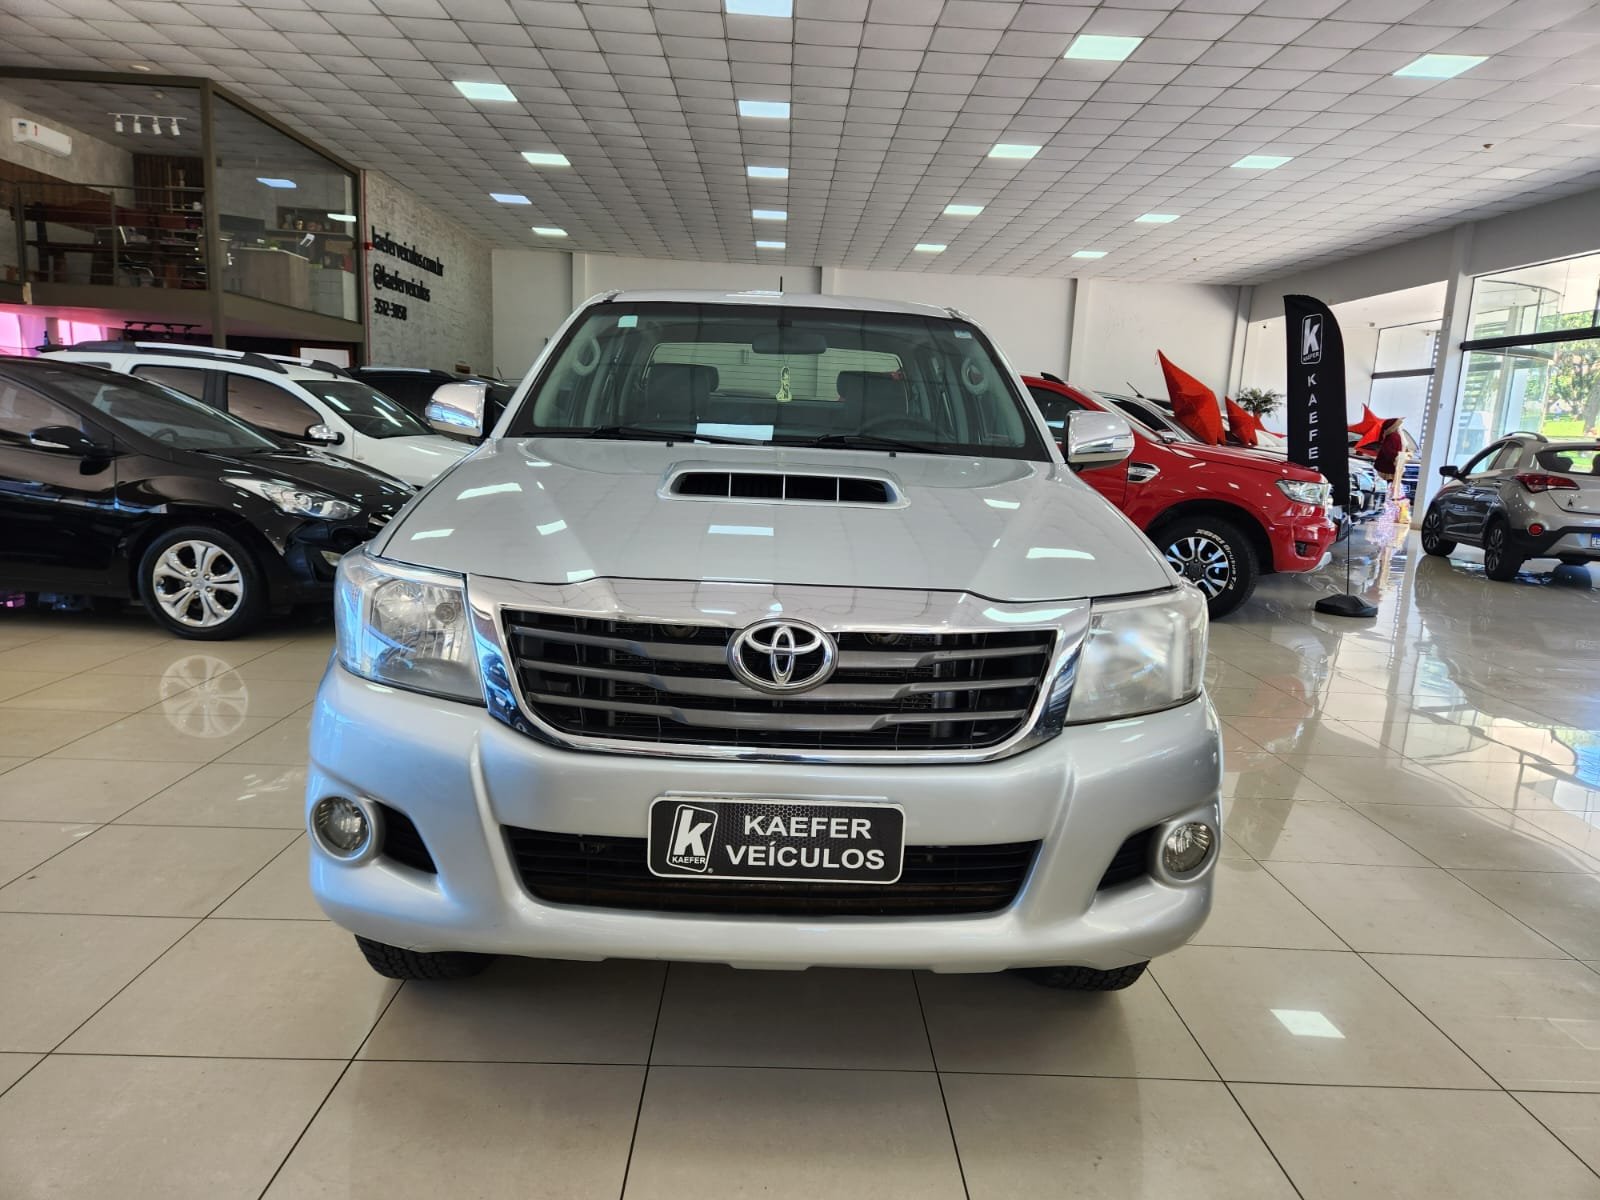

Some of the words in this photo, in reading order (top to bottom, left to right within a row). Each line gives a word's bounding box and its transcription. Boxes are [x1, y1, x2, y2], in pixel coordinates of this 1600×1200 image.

[744, 815, 872, 839] KAEFER
[672, 855, 706, 866] KAEFER
[726, 841, 886, 870] VEÍCULOS
